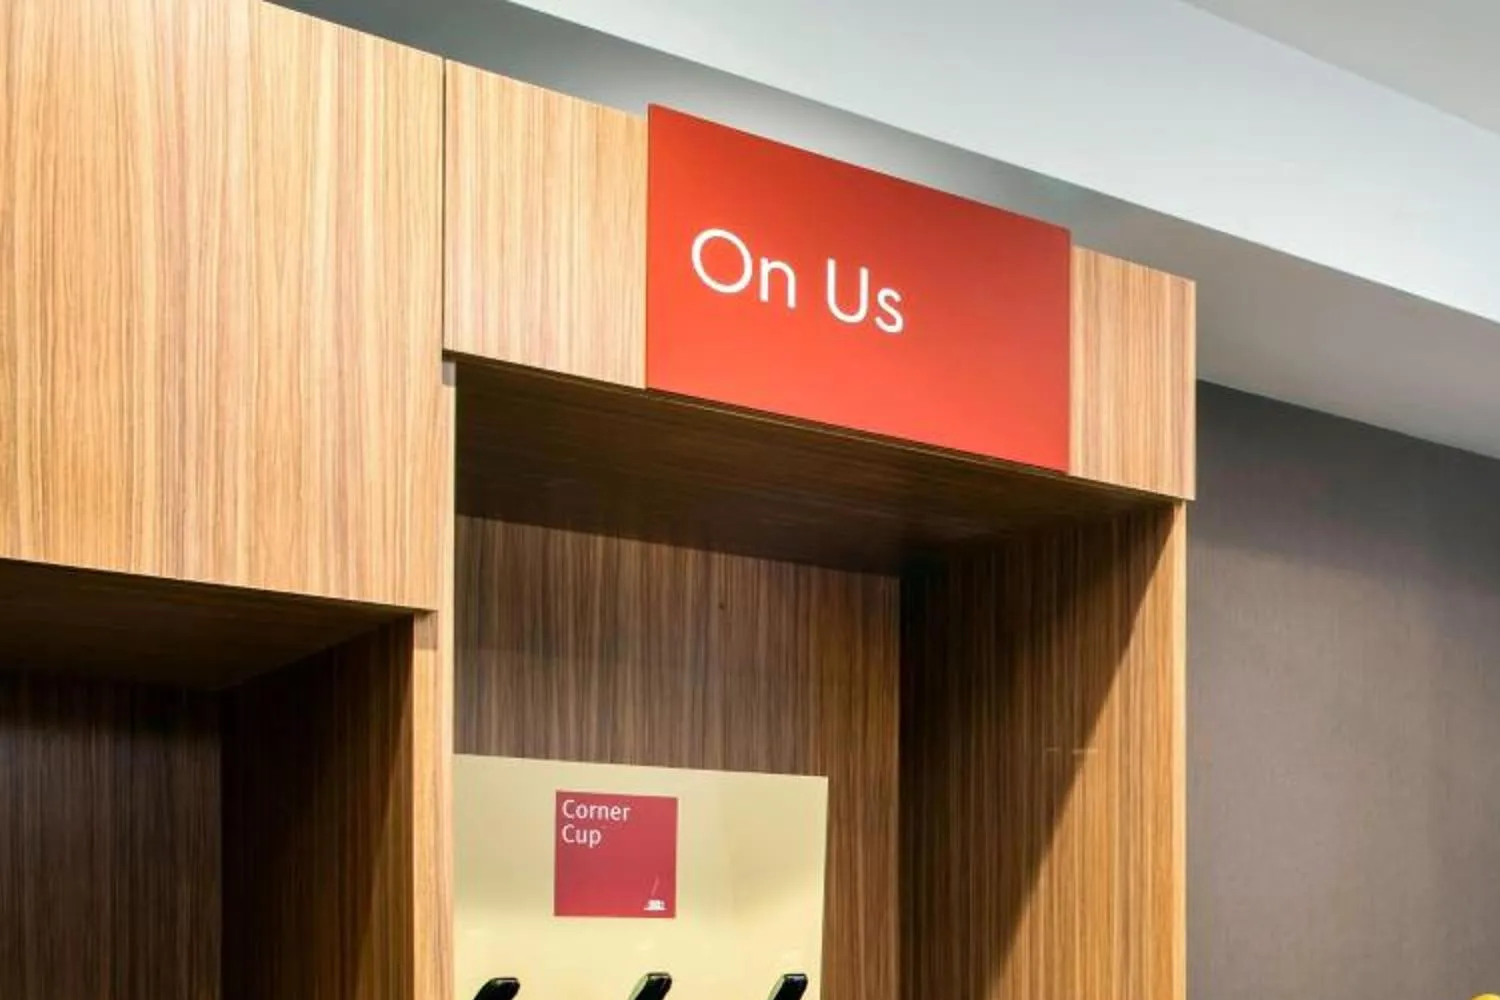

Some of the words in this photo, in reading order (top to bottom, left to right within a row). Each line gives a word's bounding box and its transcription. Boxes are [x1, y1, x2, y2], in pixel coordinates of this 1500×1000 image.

[691, 228, 797, 309] On
[826, 257, 904, 333] Us
[561, 799, 631, 821] Corner
[561, 823, 602, 848] Cup
